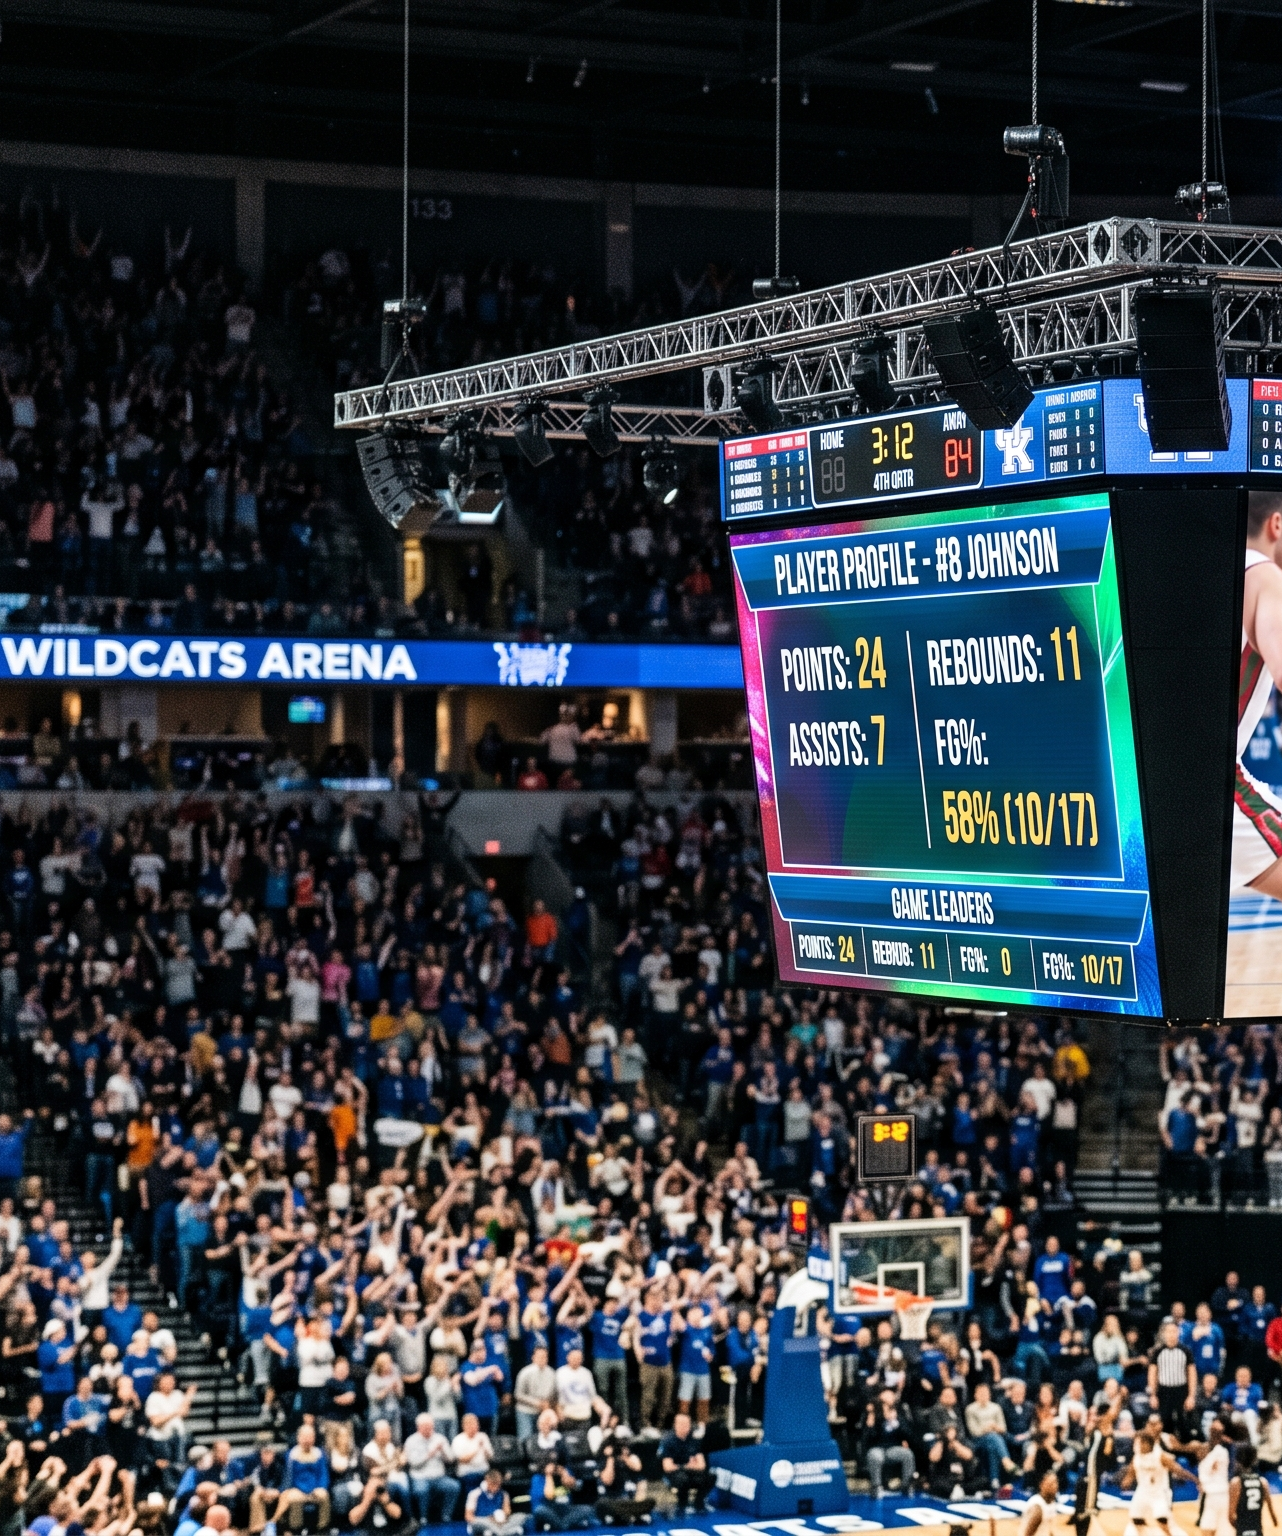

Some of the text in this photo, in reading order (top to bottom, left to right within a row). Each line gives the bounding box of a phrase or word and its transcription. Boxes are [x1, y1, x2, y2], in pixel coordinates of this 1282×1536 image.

[820, 430, 844, 450] HOME
[942, 411, 967, 432] AWAY
[871, 421, 914, 465] 3:12
[944, 437, 972, 478] 84
[873, 468, 914, 491] 4TH QRTR
[774, 544, 841, 595] PLAYER
[842, 541, 920, 591] PROFILE
[935, 536, 963, 583] #8
[967, 526, 1060, 580] JOHNSON
[1, 637, 418, 681] WILDCATS ARENA
[780, 636, 887, 692] POINTS: 24
[926, 625, 1082, 687] REBOUNDS: 11
[789, 714, 886, 767] ASSISTS: 7
[934, 718, 989, 767] FG%:
[942, 790, 1099, 847] 58% (10/17)
[891, 887, 995, 925] GAME LEADERS
[798, 934, 856, 963] POINTS: 24
[919, 942, 935, 970] 11
[1000, 947, 1012, 976] 0
[1080, 954, 1123, 985] 10/17
